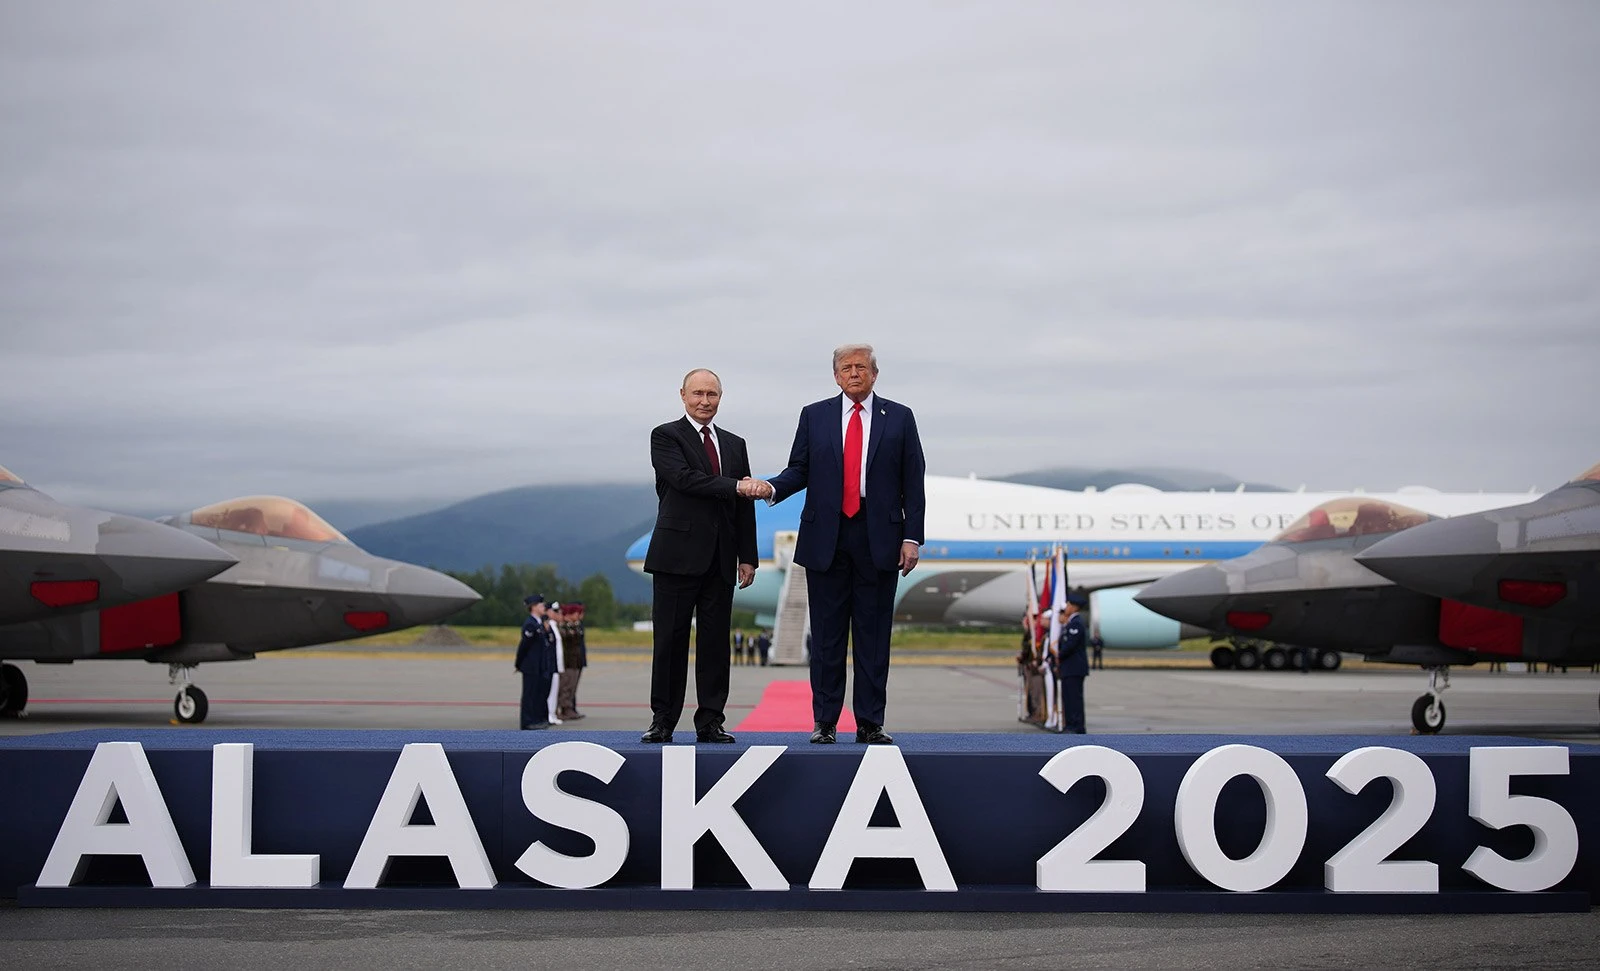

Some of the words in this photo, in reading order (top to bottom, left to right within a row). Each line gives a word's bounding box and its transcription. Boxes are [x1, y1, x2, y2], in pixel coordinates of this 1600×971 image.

[966, 513, 1095, 531] UNITED
[1110, 513, 1236, 531] STATES
[1251, 513, 1293, 531] OF
[36, 741, 958, 892] ALASKA
[1036, 744, 1579, 893] 2025
